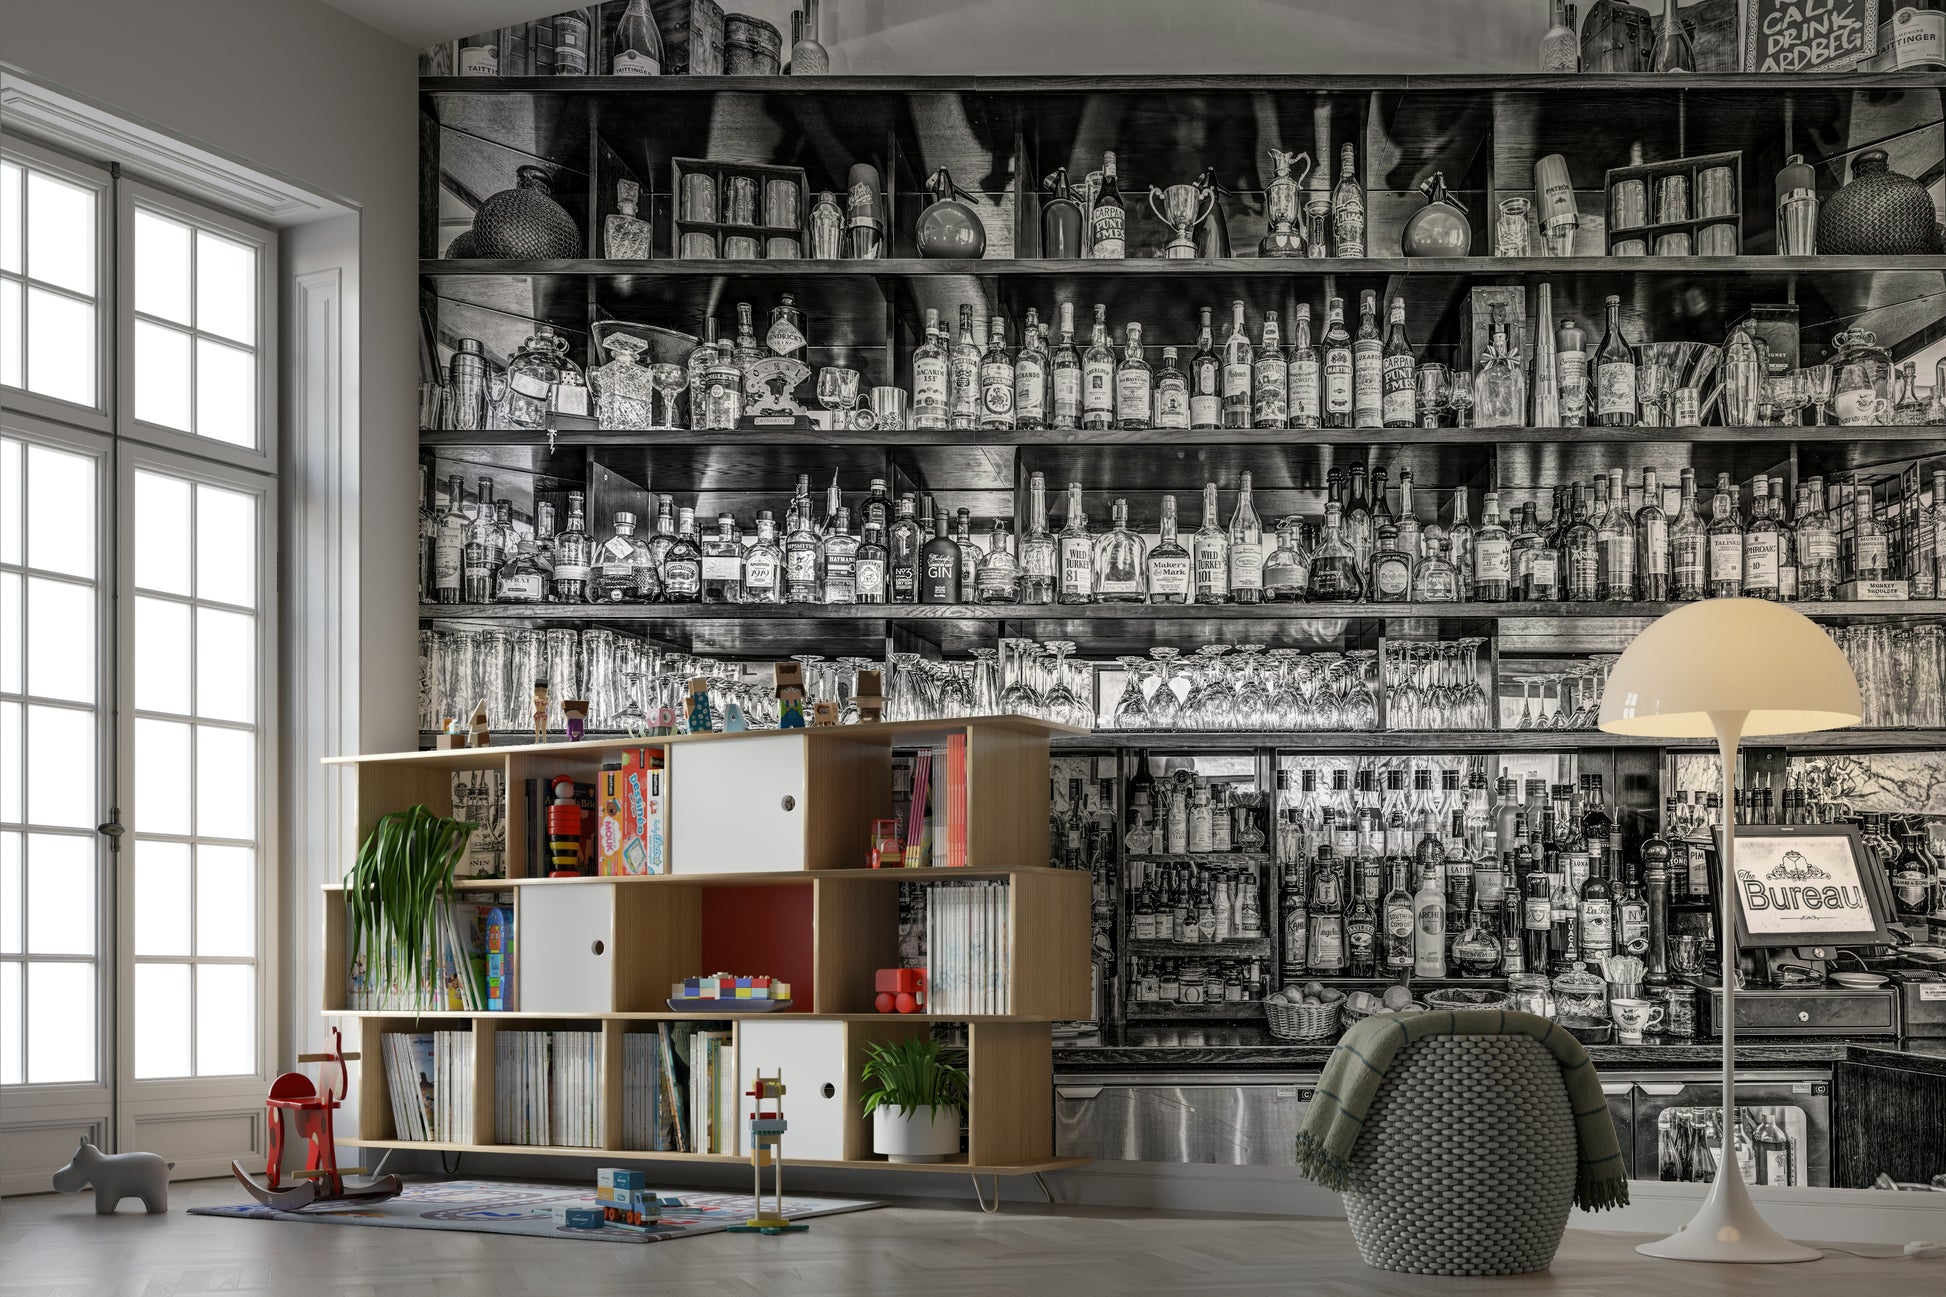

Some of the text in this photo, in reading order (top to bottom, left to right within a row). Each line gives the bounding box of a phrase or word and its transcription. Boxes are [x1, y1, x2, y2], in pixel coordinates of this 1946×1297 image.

[1767, 4, 1857, 55] DRINK
[1760, 23, 1863, 72] ARDBEG
[1878, 33, 1936, 55] AITTINGER
[1095, 218, 1122, 233] PUNT
[1384, 369, 1412, 384] PUNT
[1069, 549, 1087, 560] WILD
[1200, 550, 1219, 560] WILD
[1065, 558, 1090, 570] TURKEY
[1153, 562, 1187, 570] Maker's
[1197, 559, 1223, 570] TURKEY
[751, 569, 771, 578] 1919
[928, 567, 953, 579] GIN
[1065, 569, 1079, 582] 81
[1162, 568, 1186, 576] Mark
[1197, 570, 1212, 583] 101
[604, 820, 613, 852] MOUK
[1737, 869, 1756, 880] The
[1743, 879, 1863, 910] Bureau
[1390, 921, 1413, 929] COMFORT
[1567, 917, 1575, 949] TUACA
